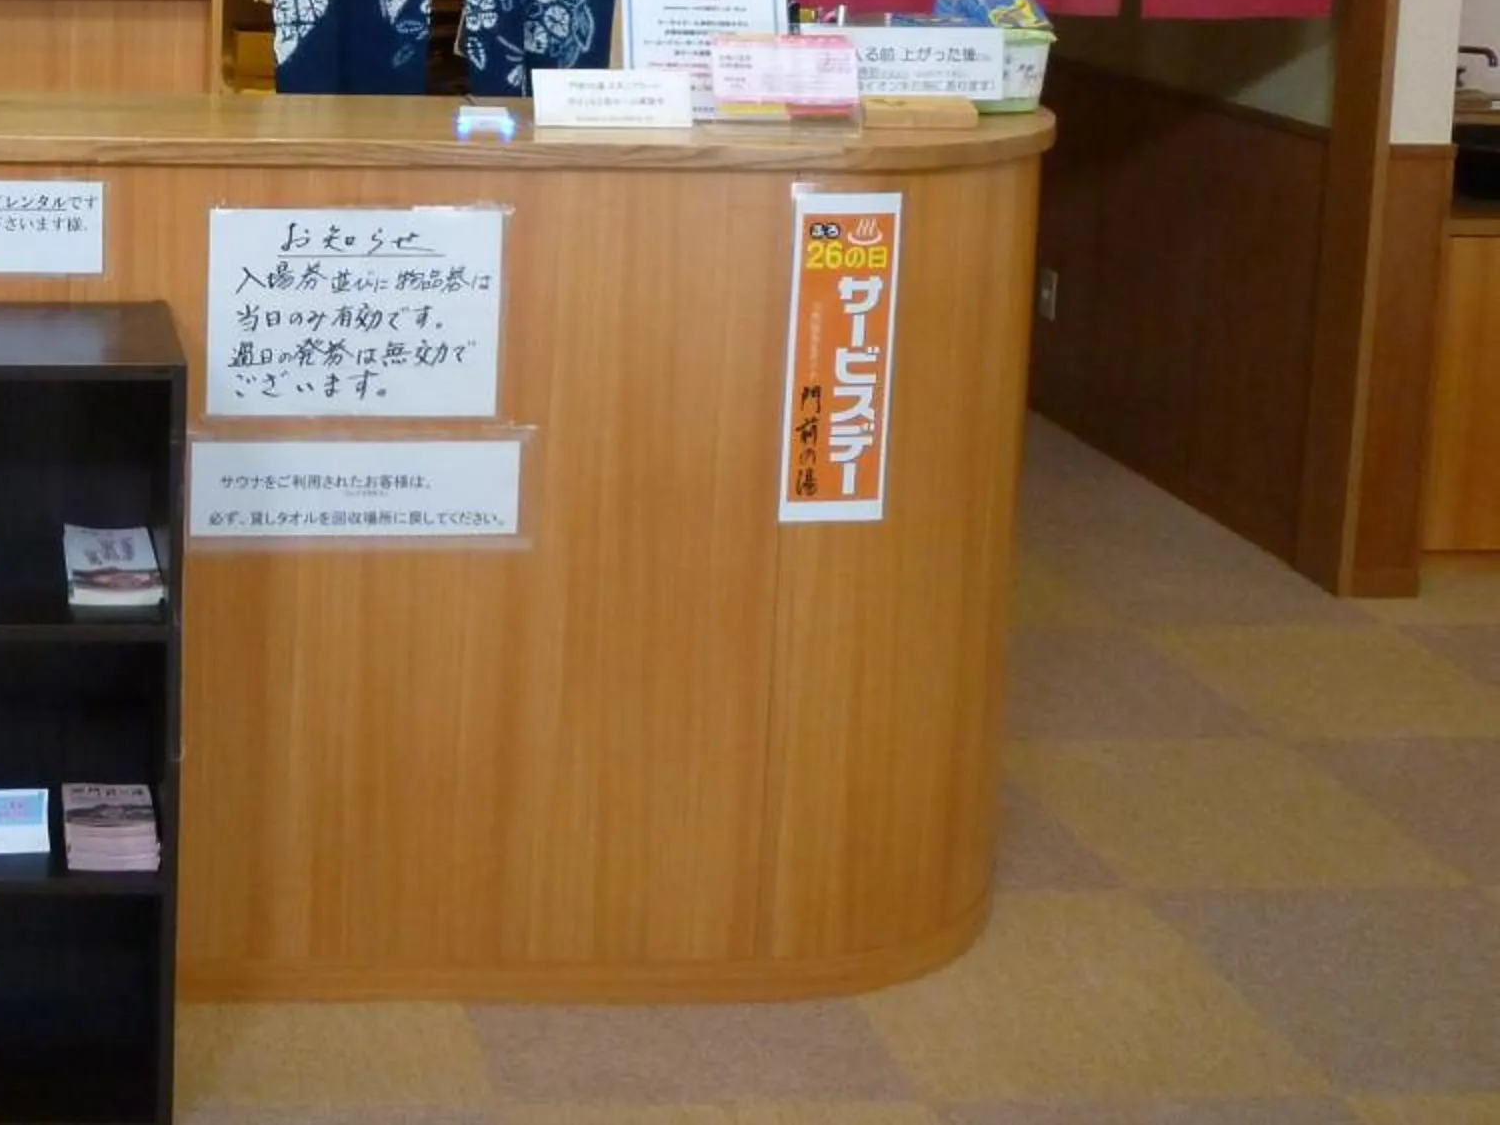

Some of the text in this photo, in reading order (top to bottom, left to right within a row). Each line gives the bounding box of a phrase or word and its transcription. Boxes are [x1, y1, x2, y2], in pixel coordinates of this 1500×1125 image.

[280, 223, 437, 254] お知らせ
[806, 241, 888, 269] 26の日
[236, 302, 443, 332] 当日のみ有効です。
[234, 370, 388, 399] ございます。
[829, 276, 884, 495] サービスデー
[795, 386, 822, 497] 門前の湯
